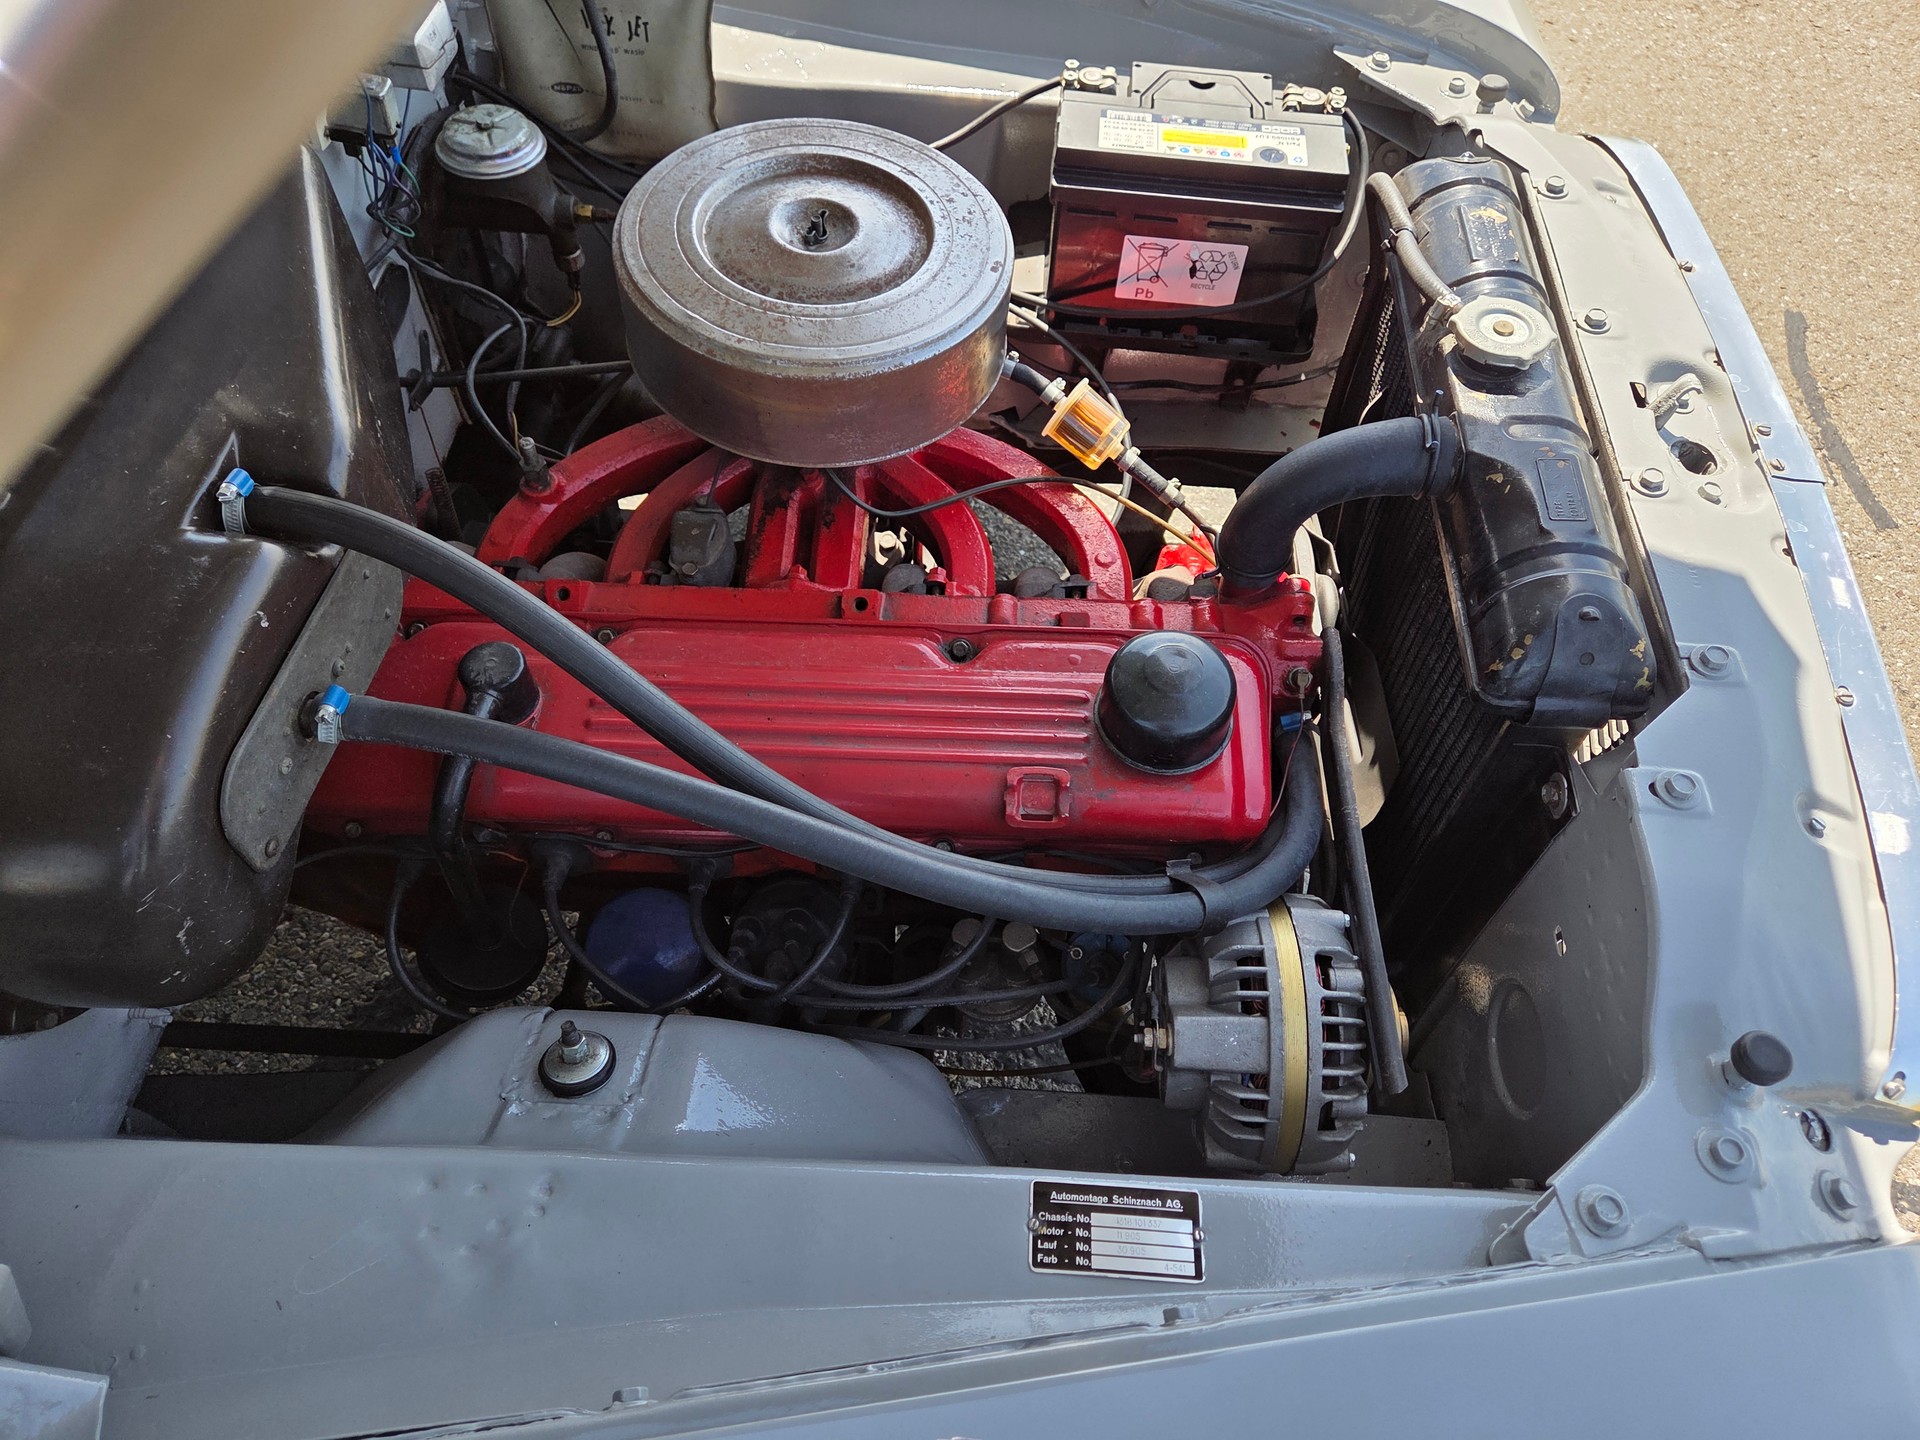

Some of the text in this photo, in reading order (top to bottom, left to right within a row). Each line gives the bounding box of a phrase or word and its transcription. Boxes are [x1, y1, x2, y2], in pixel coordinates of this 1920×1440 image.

[628, 15, 649, 43] JET
[1227, 250, 1240, 271] RETURN
[1134, 287, 1154, 299] Pb
[1190, 282, 1216, 291] RECYCLE
[1050, 1191, 1184, 1209] Automontage Schinznach AG.
[1038, 1226, 1064, 1236] Motor
[1075, 1227, 1091, 1238] No.
[1038, 1239, 1057, 1250] Lauf
[1075, 1242, 1092, 1252] No.
[1037, 1253, 1058, 1264] Farb
[1075, 1256, 1091, 1266] No.
